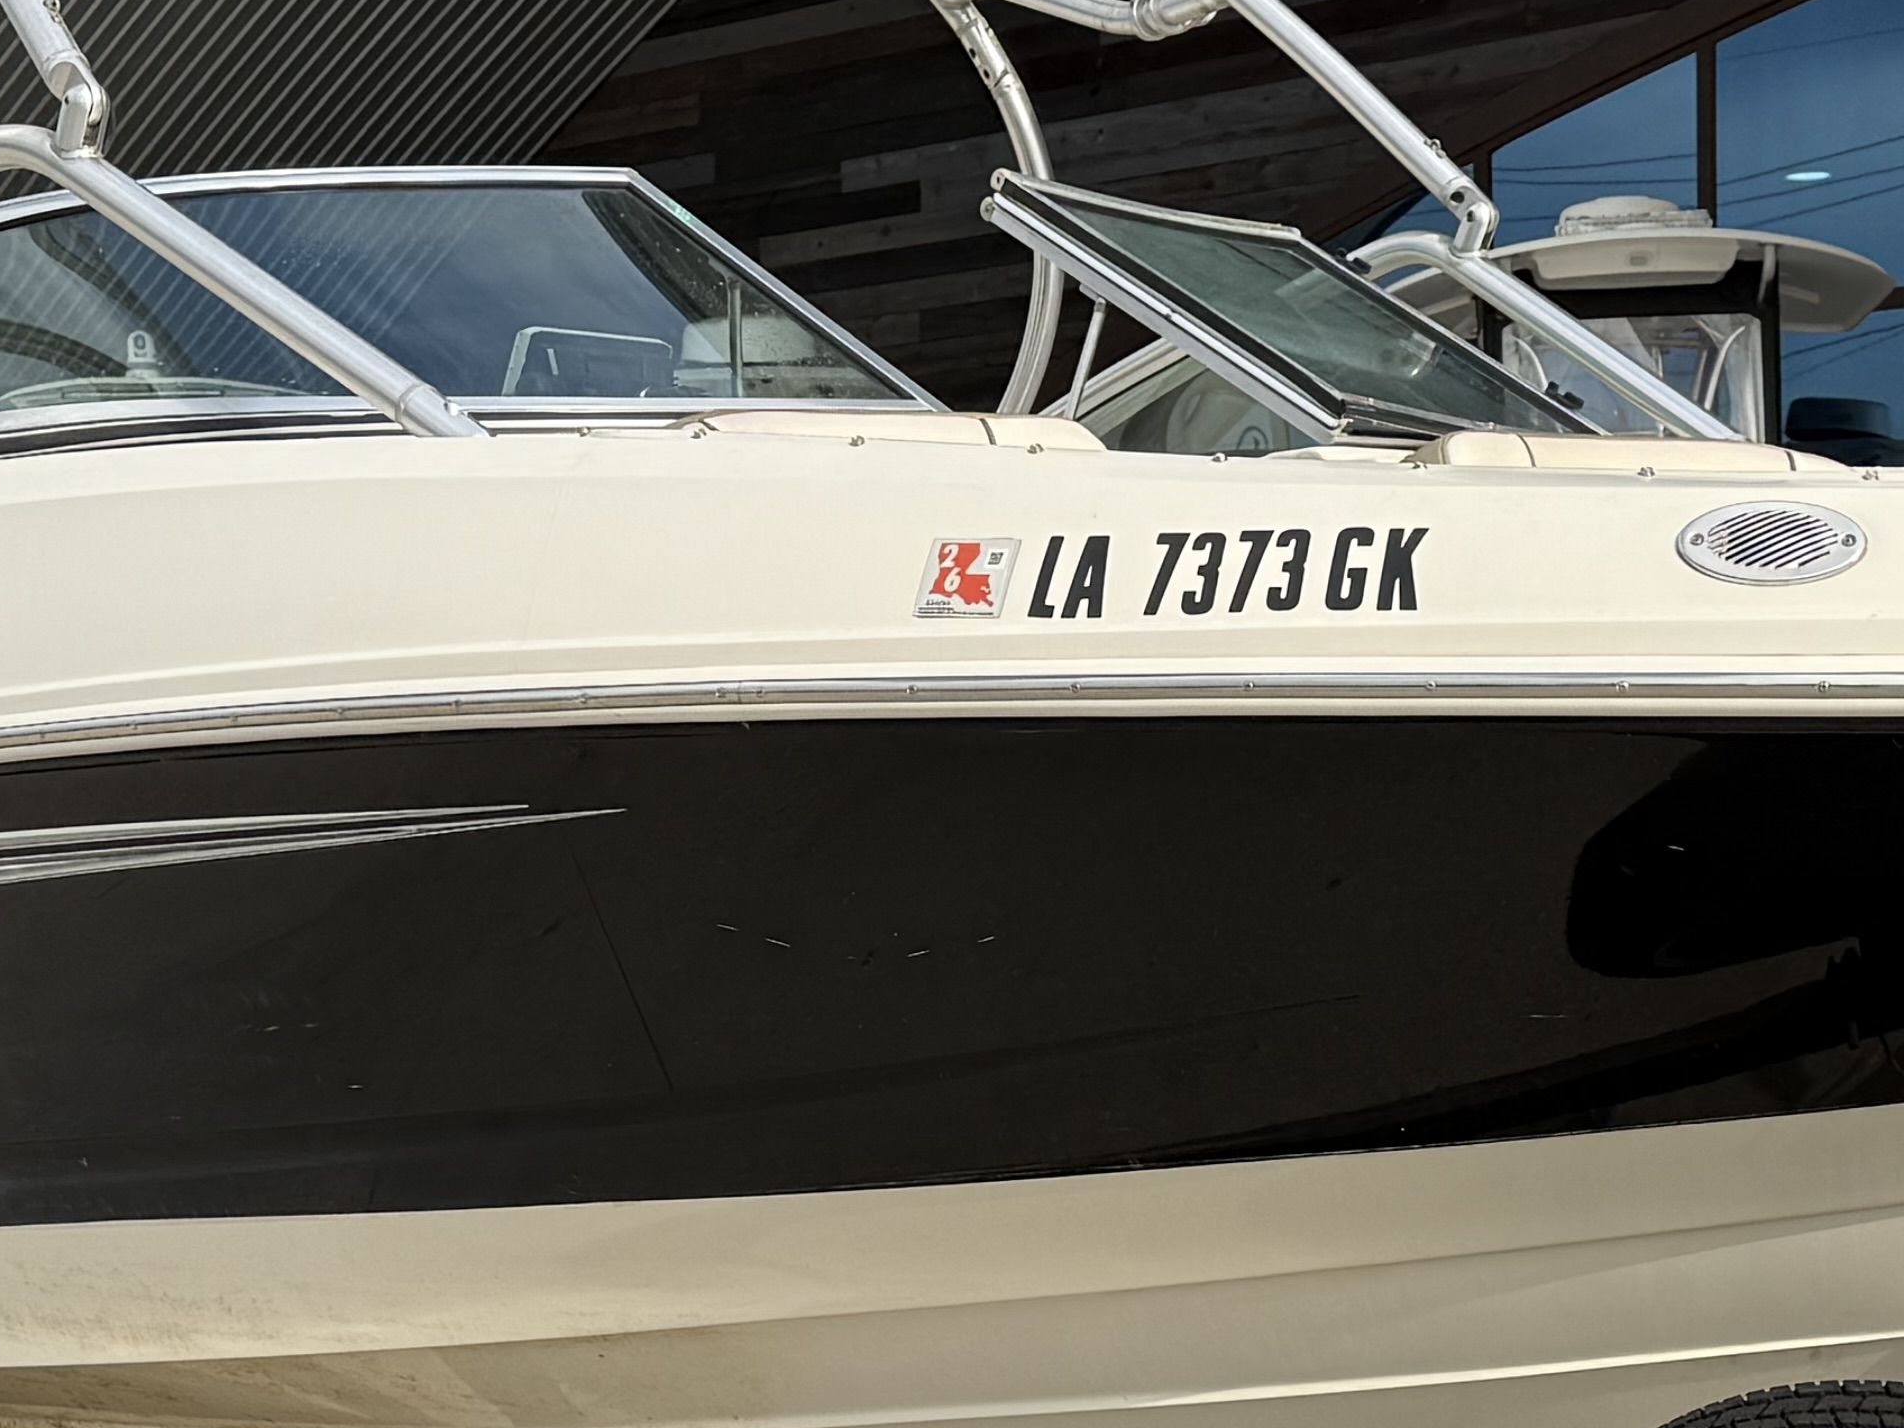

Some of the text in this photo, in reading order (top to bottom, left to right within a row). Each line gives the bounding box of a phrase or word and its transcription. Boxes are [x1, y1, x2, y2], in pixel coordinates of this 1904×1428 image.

[1027, 527, 1430, 619] LA 7373 GK
